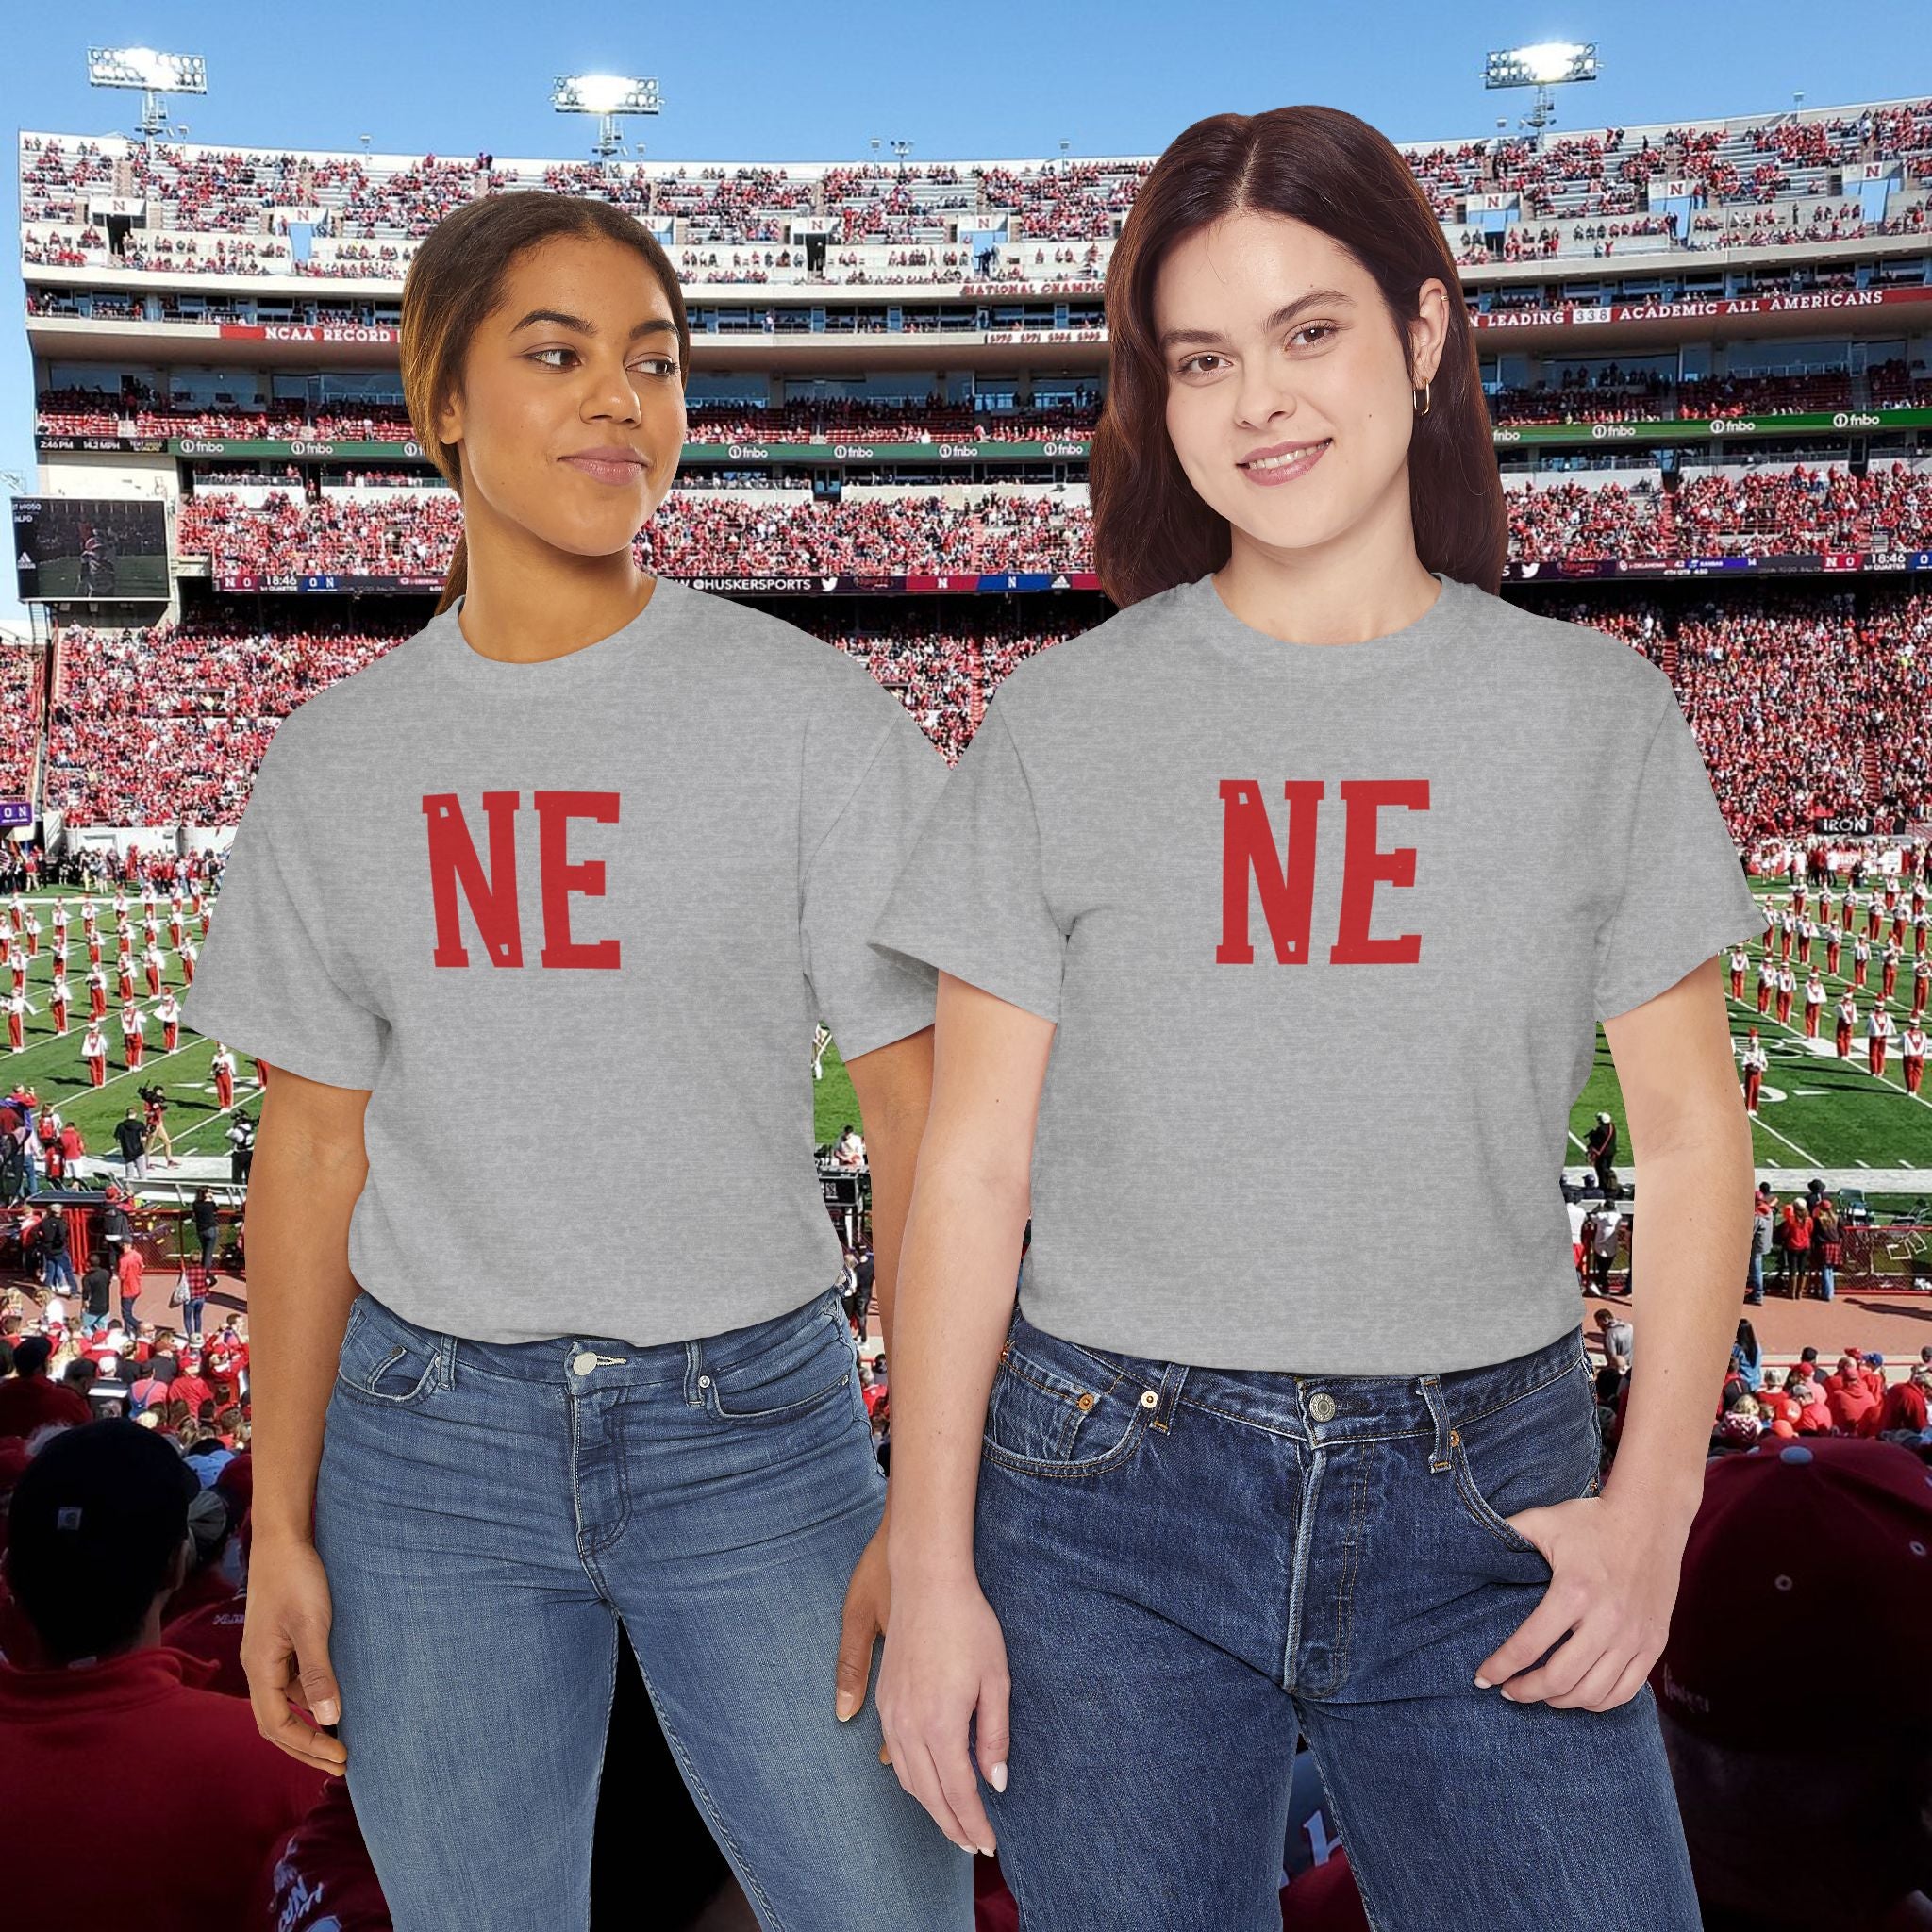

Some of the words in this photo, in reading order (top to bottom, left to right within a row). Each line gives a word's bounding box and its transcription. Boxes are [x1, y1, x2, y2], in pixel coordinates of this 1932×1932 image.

[1866, 165, 1880, 178] N
[1670, 183, 1683, 195] N
[113, 200, 125, 211] N
[1488, 195, 1500, 208] N
[297, 209, 309, 221] N
[812, 220, 824, 231] N
[978, 218, 990, 229] N
[963, 282, 1036, 295] NATIONAL
[1487, 310, 1565, 327] LEADING
[1574, 309, 1609, 323] 338
[1619, 303, 1718, 321] ACADEMIC
[1725, 299, 1761, 314] ALL
[1769, 291, 1884, 311] AMERICANS
[265, 326, 316, 341] NCAA
[323, 329, 391, 342] RECORD
[1725, 419, 1756, 432] fnbo
[1849, 413, 1880, 426] fnbo
[1493, 429, 1521, 441] fnbo
[1607, 425, 1637, 439] fnbo
[196, 441, 225, 453] fnbo
[306, 441, 334, 455] fnbo
[742, 446, 769, 458] fnbo
[849, 446, 874, 458] fnbo
[953, 444, 978, 457] fnbo
[1058, 443, 1083, 456] fnbo
[1825, 557, 1838, 568] N
[1871, 553, 1907, 564] 18:46
[225, 576, 236, 588] N
[265, 575, 298, 586] 18:46
[692, 578, 812, 591] @HUSKERSPORTS
[937, 577, 948, 589] N
[1008, 575, 1017, 589] N
[1824, 818, 1868, 832] IRON
[1216, 779, 1430, 965] NE
[422, 791, 621, 969] NE
